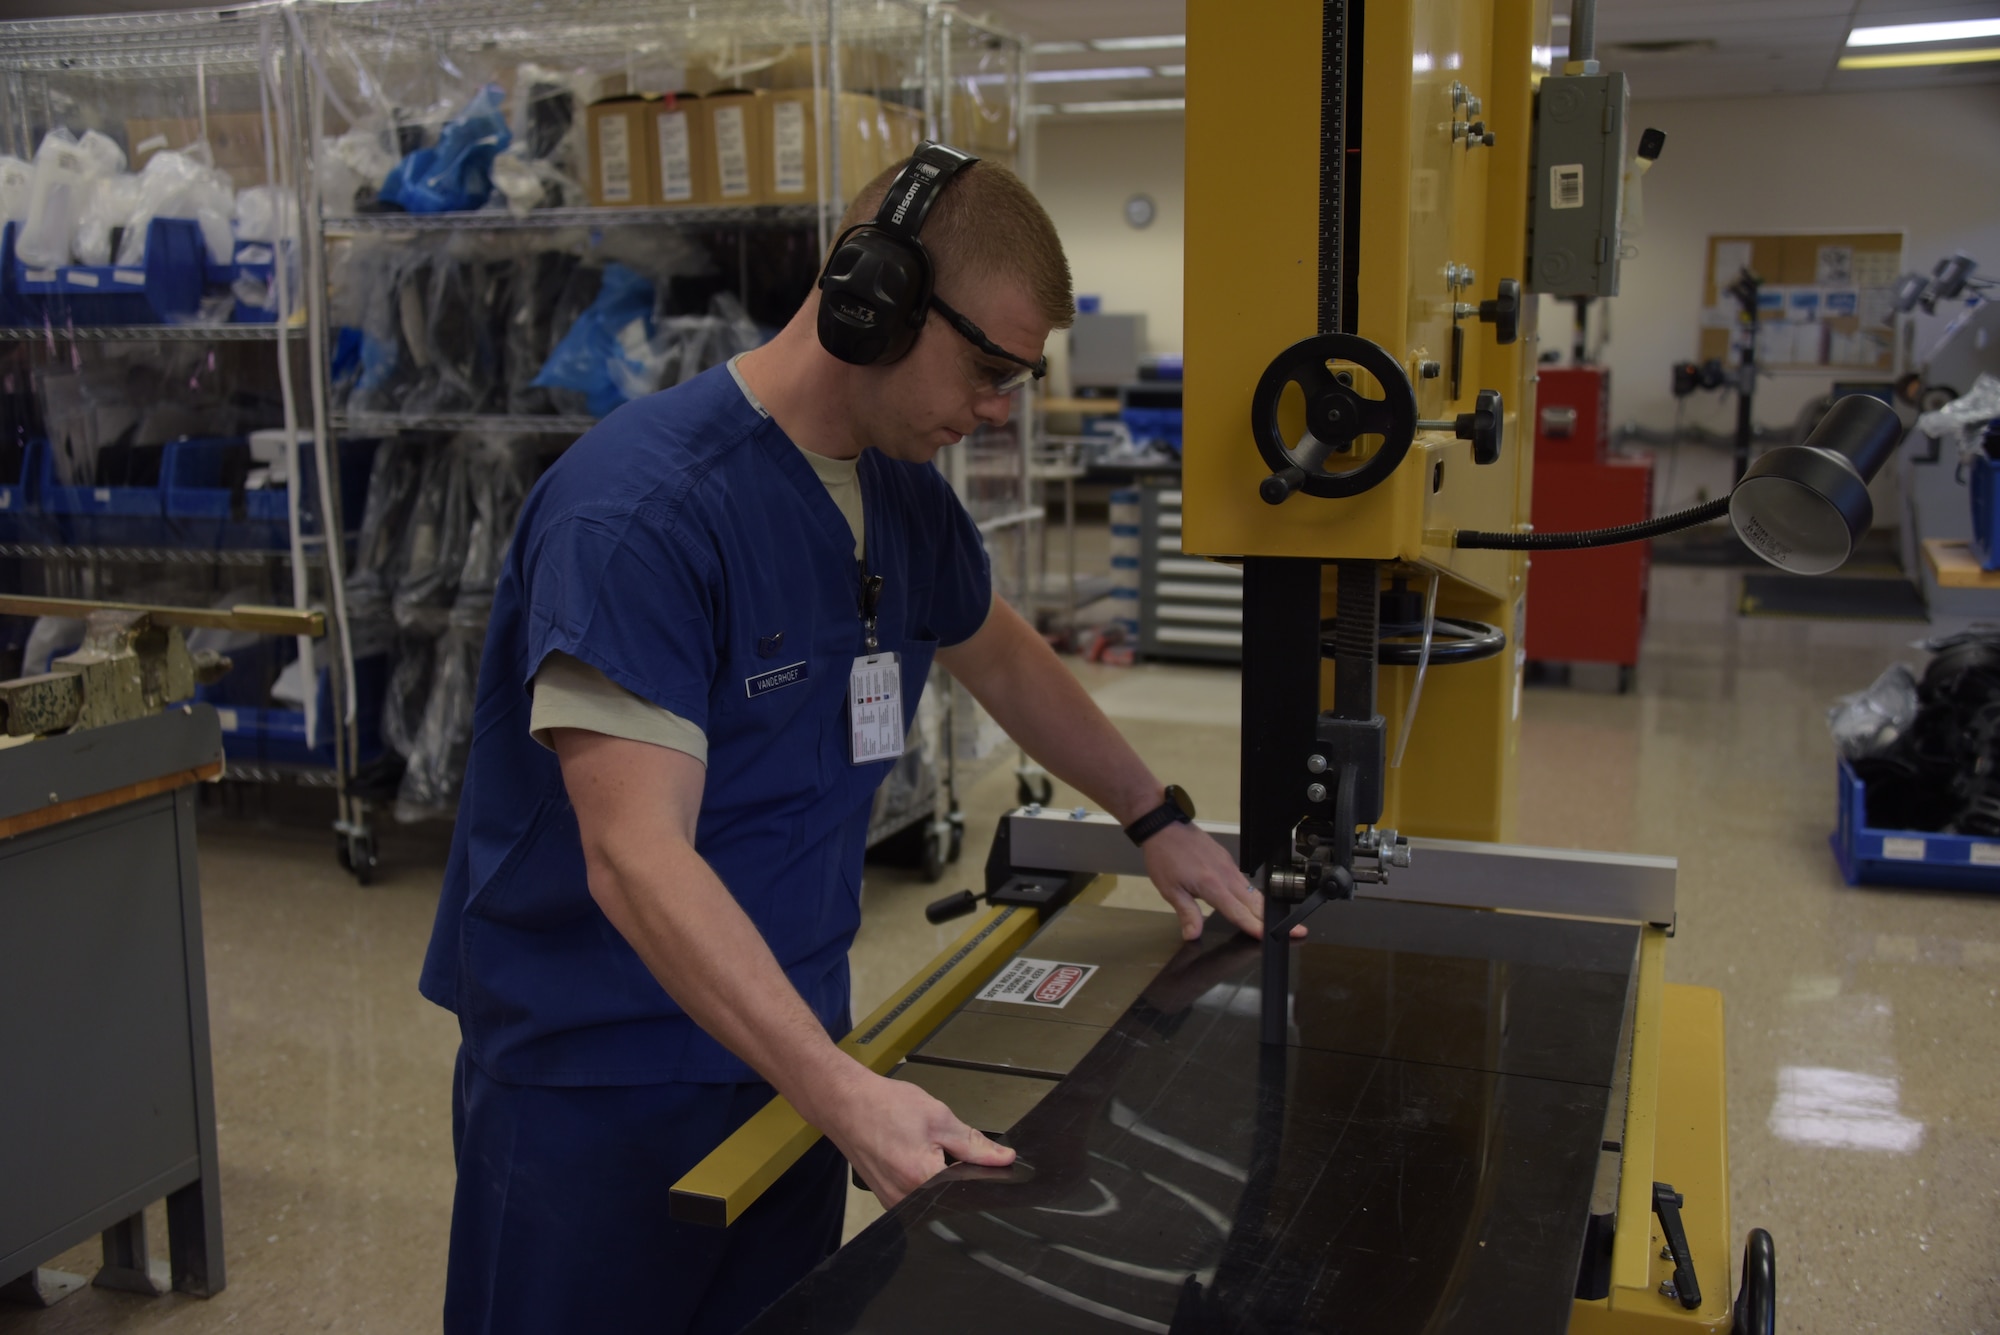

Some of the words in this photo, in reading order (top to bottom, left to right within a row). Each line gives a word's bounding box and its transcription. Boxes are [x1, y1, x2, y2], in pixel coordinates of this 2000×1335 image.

[891, 182, 921, 226] Bilsom
[757, 669, 799, 690] VANDERHOEF
[1037, 968, 1080, 1001] DANGER
